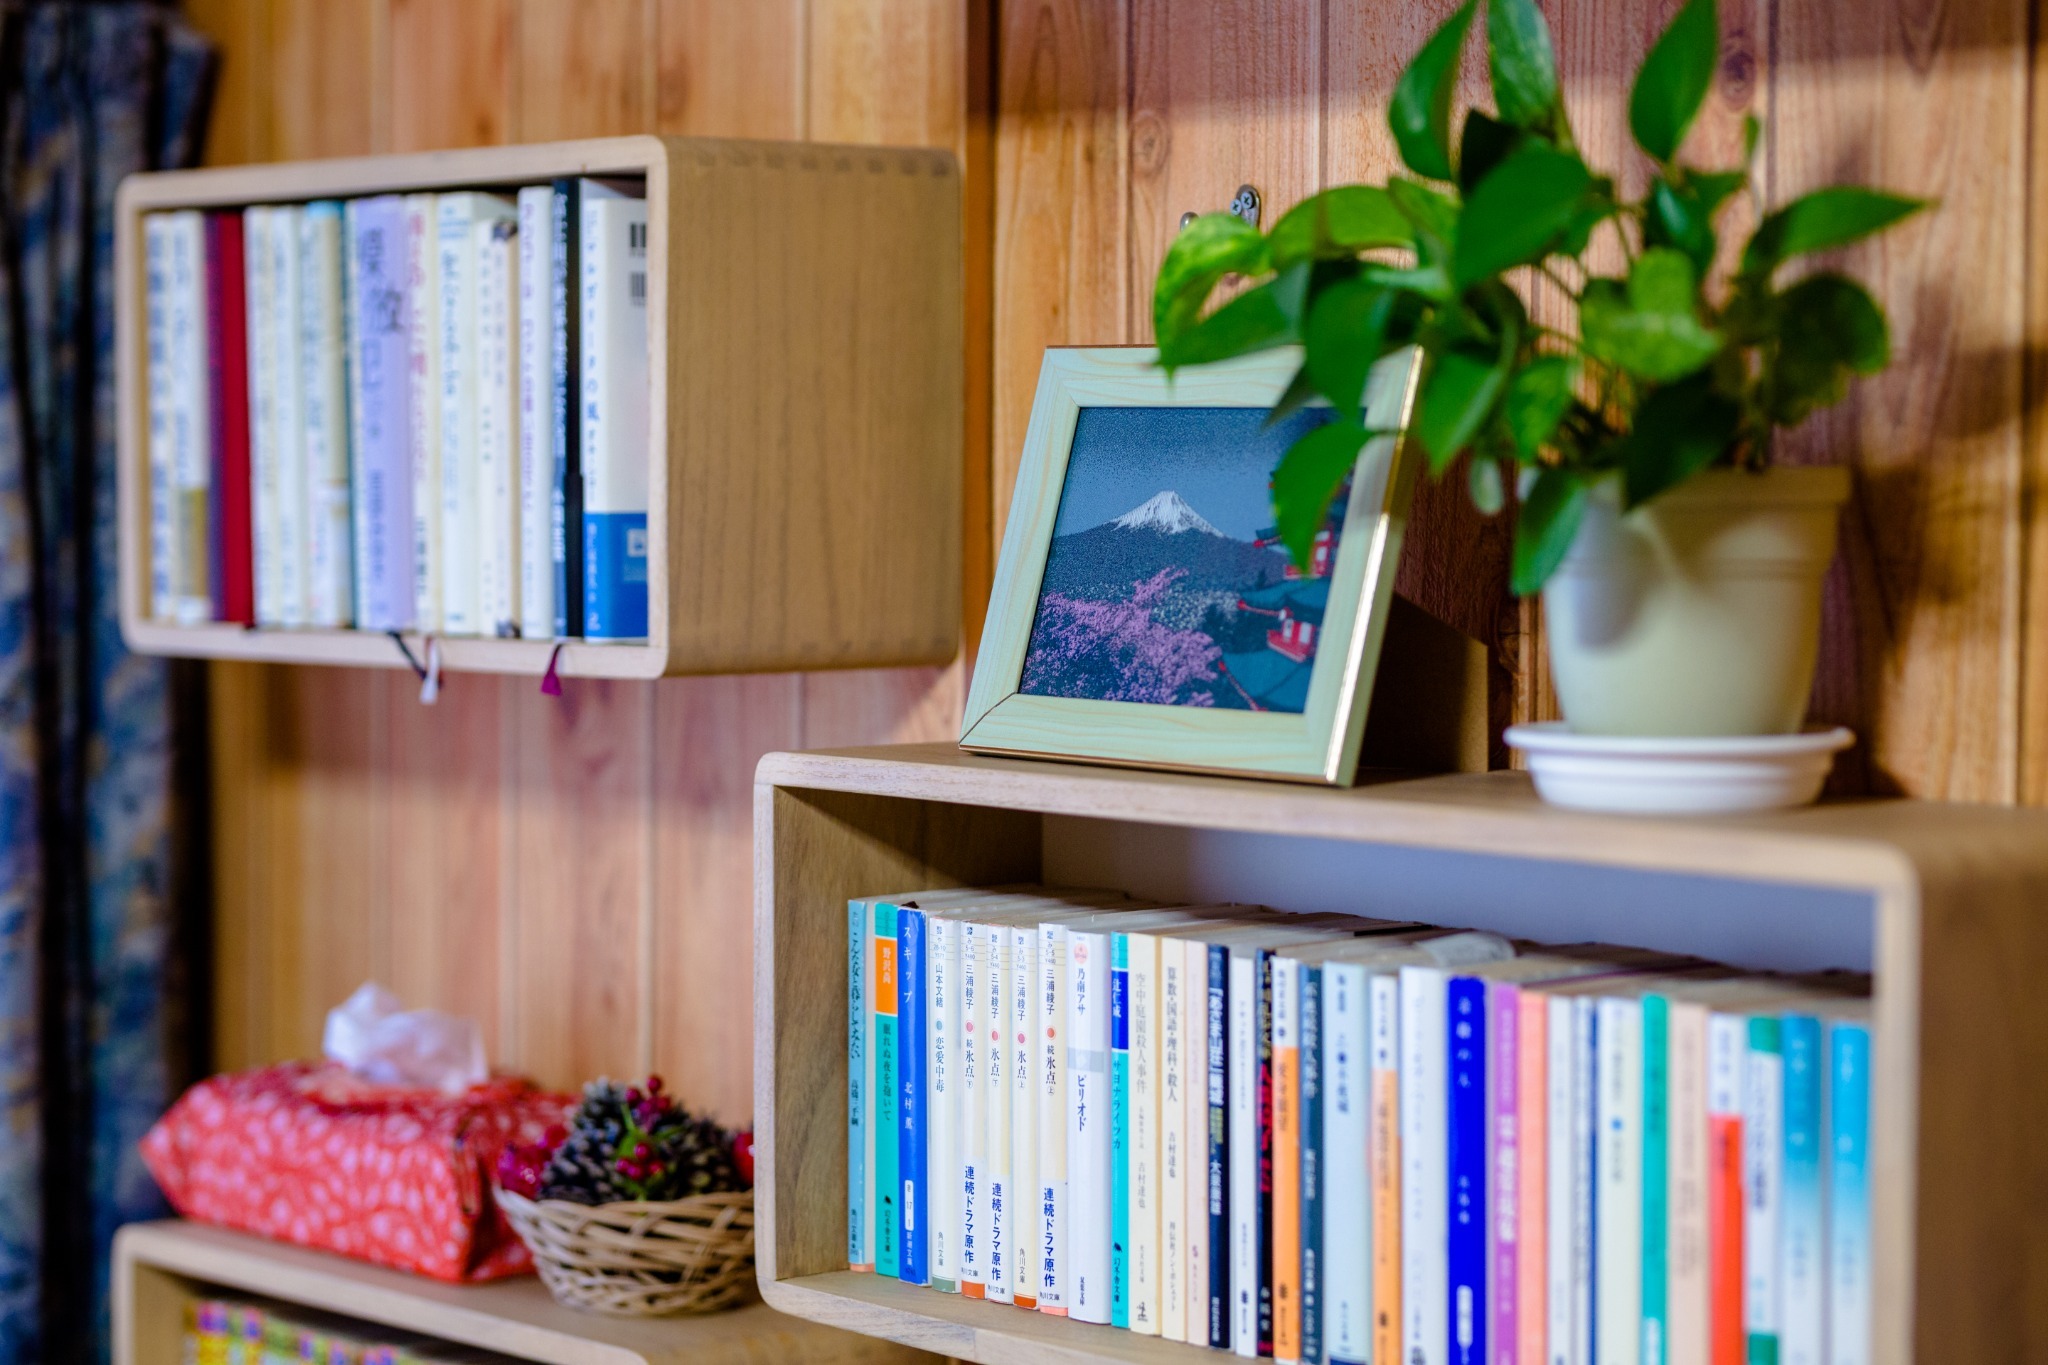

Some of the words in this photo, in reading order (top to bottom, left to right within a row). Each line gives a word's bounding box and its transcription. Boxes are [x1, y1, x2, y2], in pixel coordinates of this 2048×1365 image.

[903, 926, 913, 1003] スキップ
[935, 962, 944, 1008] 山本文緒
[965, 964, 974, 1010] 三浦綾子
[991, 973, 999, 1019] 三浦綾子
[1017, 975, 1026, 1021] 三浦綾子
[1046, 968, 1055, 1015] 三浦綾子
[1077, 968, 1086, 1015] 乃南アサ
[1112, 978, 1122, 1018] 辻仁成
[1135, 973, 1146, 1095] 空中庭園殺人事件
[1167, 966, 1178, 1102] 算数・国語・理科・殺人
[883, 1022, 892, 1121] 眠れぬ夜を抱いて
[935, 1036, 945, 1093] 恋愛中毒
[904, 1082, 914, 1130] 北村薫
[1077, 1074, 1087, 1132] ピリオド
[1112, 1059, 1121, 1149] サヨナライツカ
[964, 1165, 975, 1264] 連続ドラマ原作
[991, 1182, 1002, 1281] 連続ドラマ原作
[1043, 1187, 1055, 1287] 連続ドラマ原作
[937, 1231, 945, 1267] 角川文庫
[961, 1266, 979, 1277] 角川文庫
[987, 1284, 1006, 1295] 角川文庫
[1039, 1290, 1060, 1301] 角川文庫
